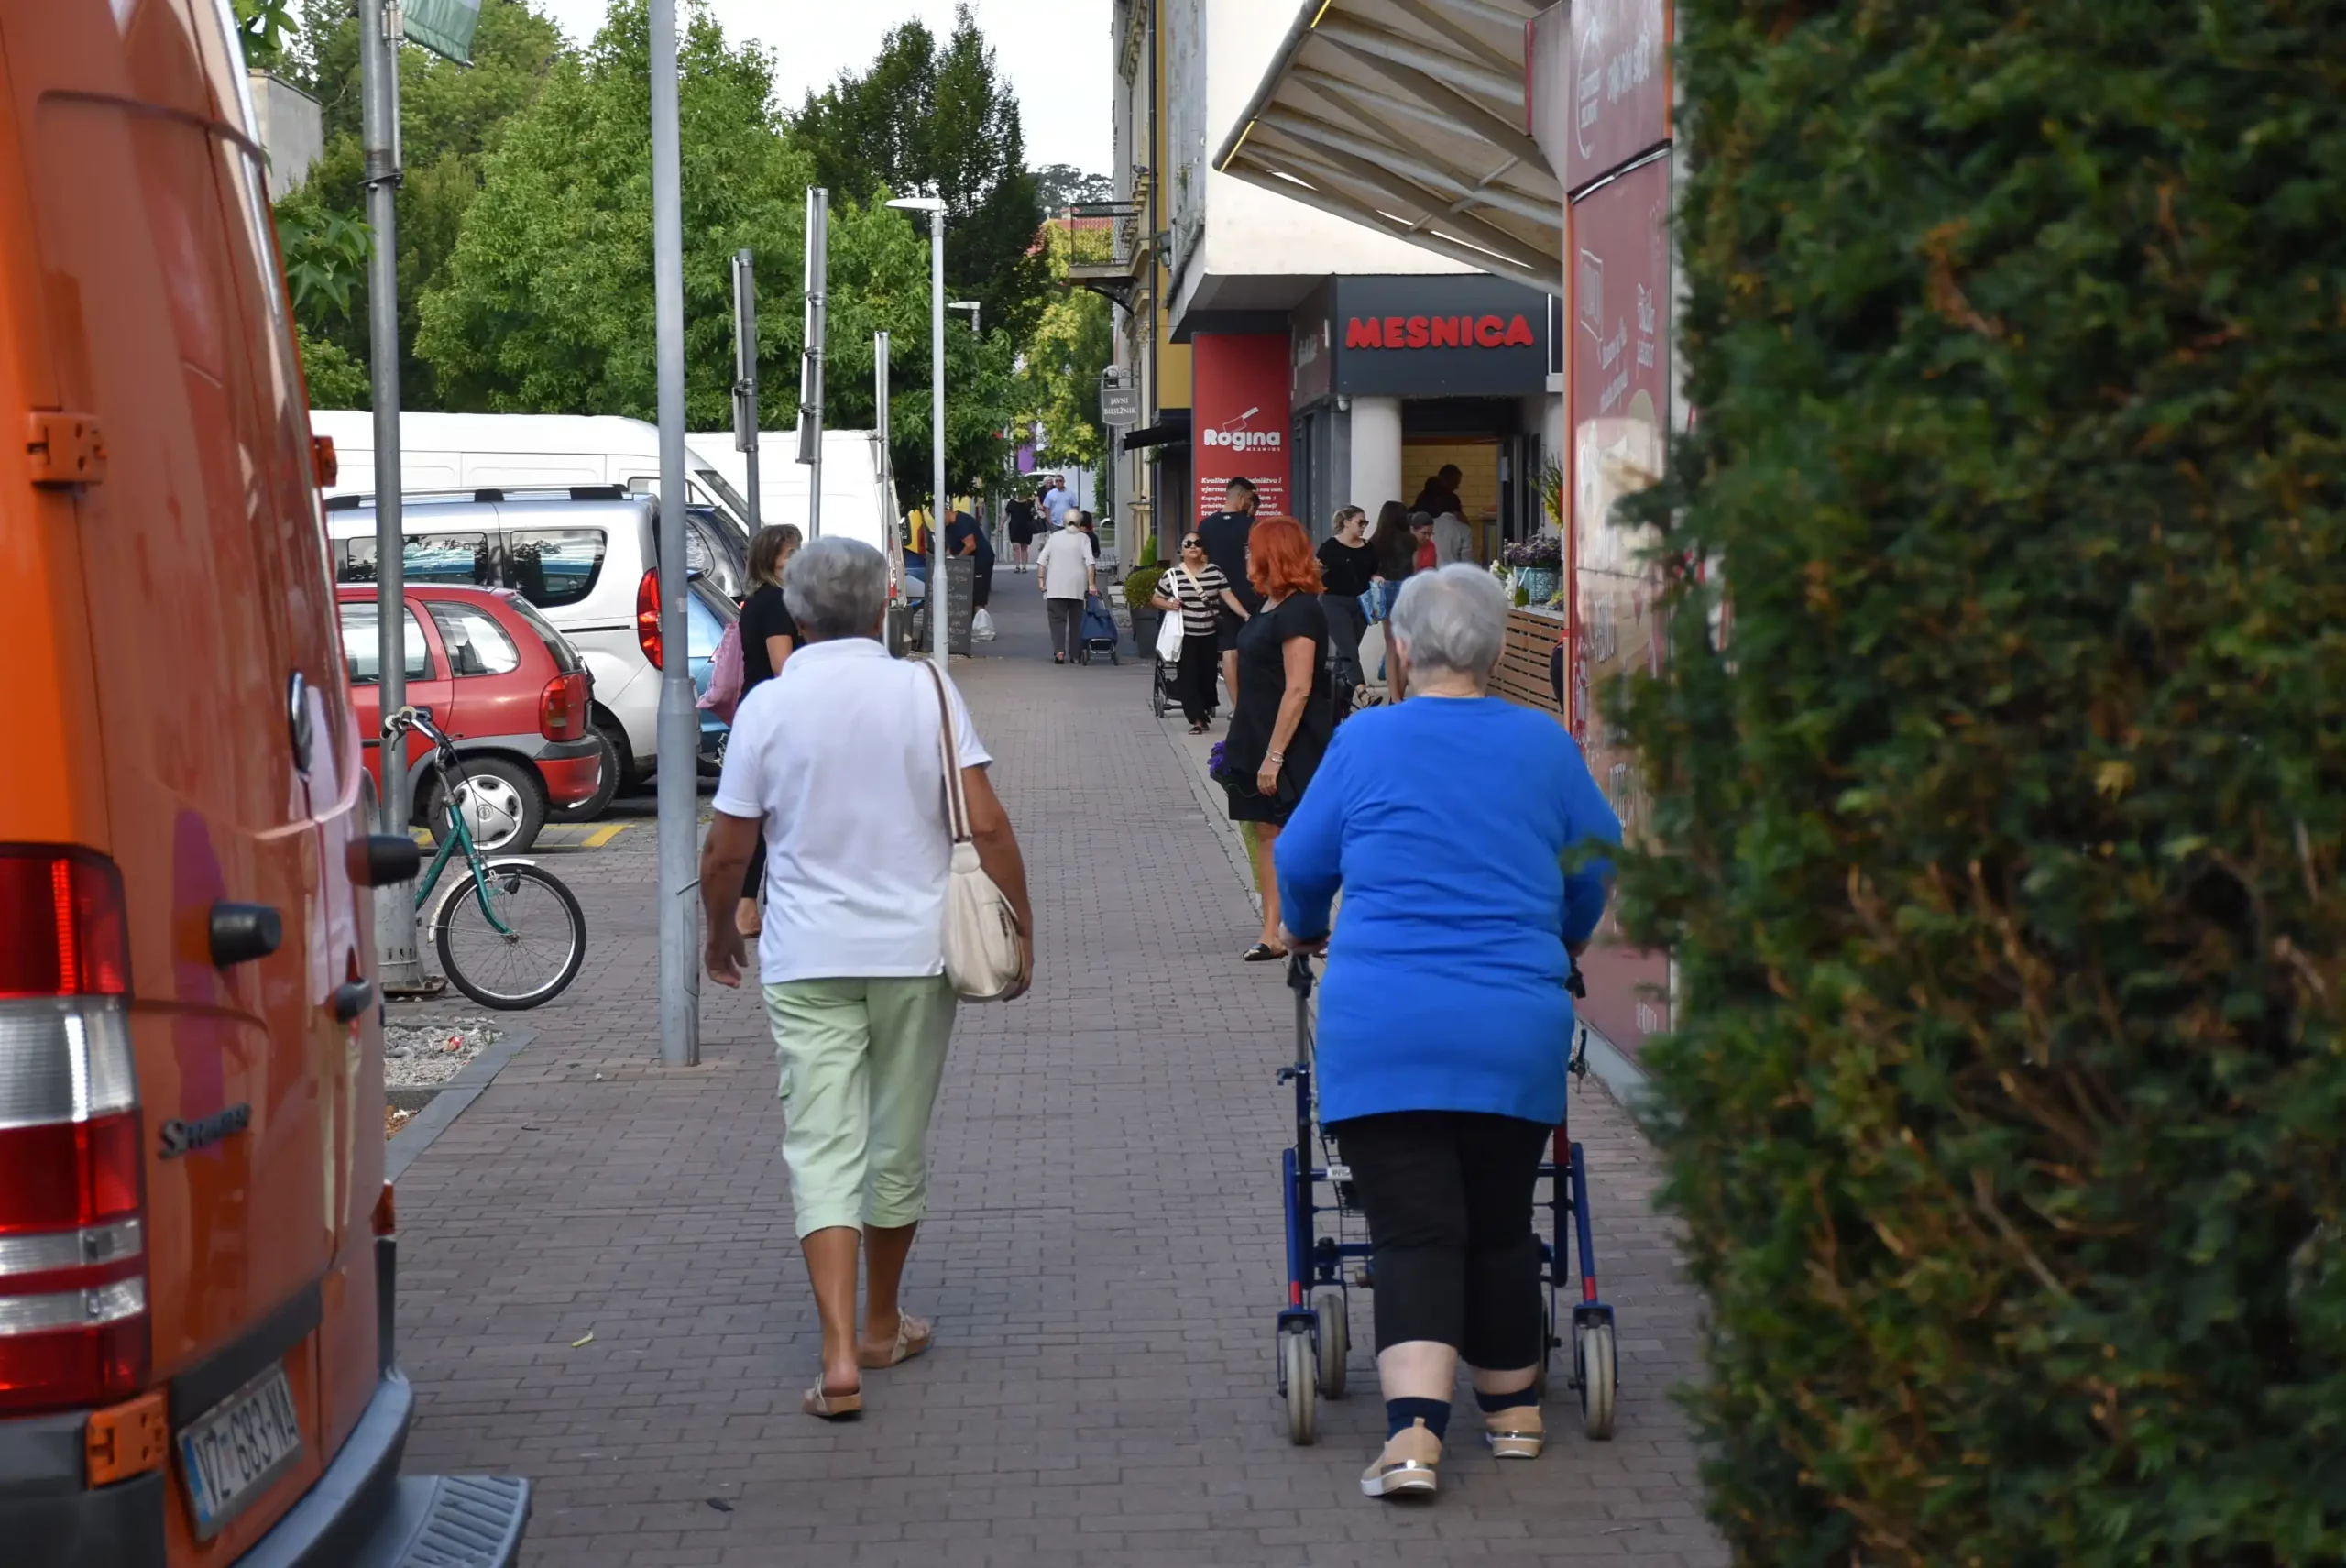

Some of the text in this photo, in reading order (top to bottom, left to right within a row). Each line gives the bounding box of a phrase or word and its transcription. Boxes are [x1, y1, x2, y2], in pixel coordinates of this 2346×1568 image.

[1345, 314, 1534, 349] MESNICA
[1103, 406, 1137, 415] BILJEŽNIK
[1110, 397, 1129, 406] JAVNI
[1203, 428, 1281, 452] Rogina
[194, 1426, 232, 1508] VZ
